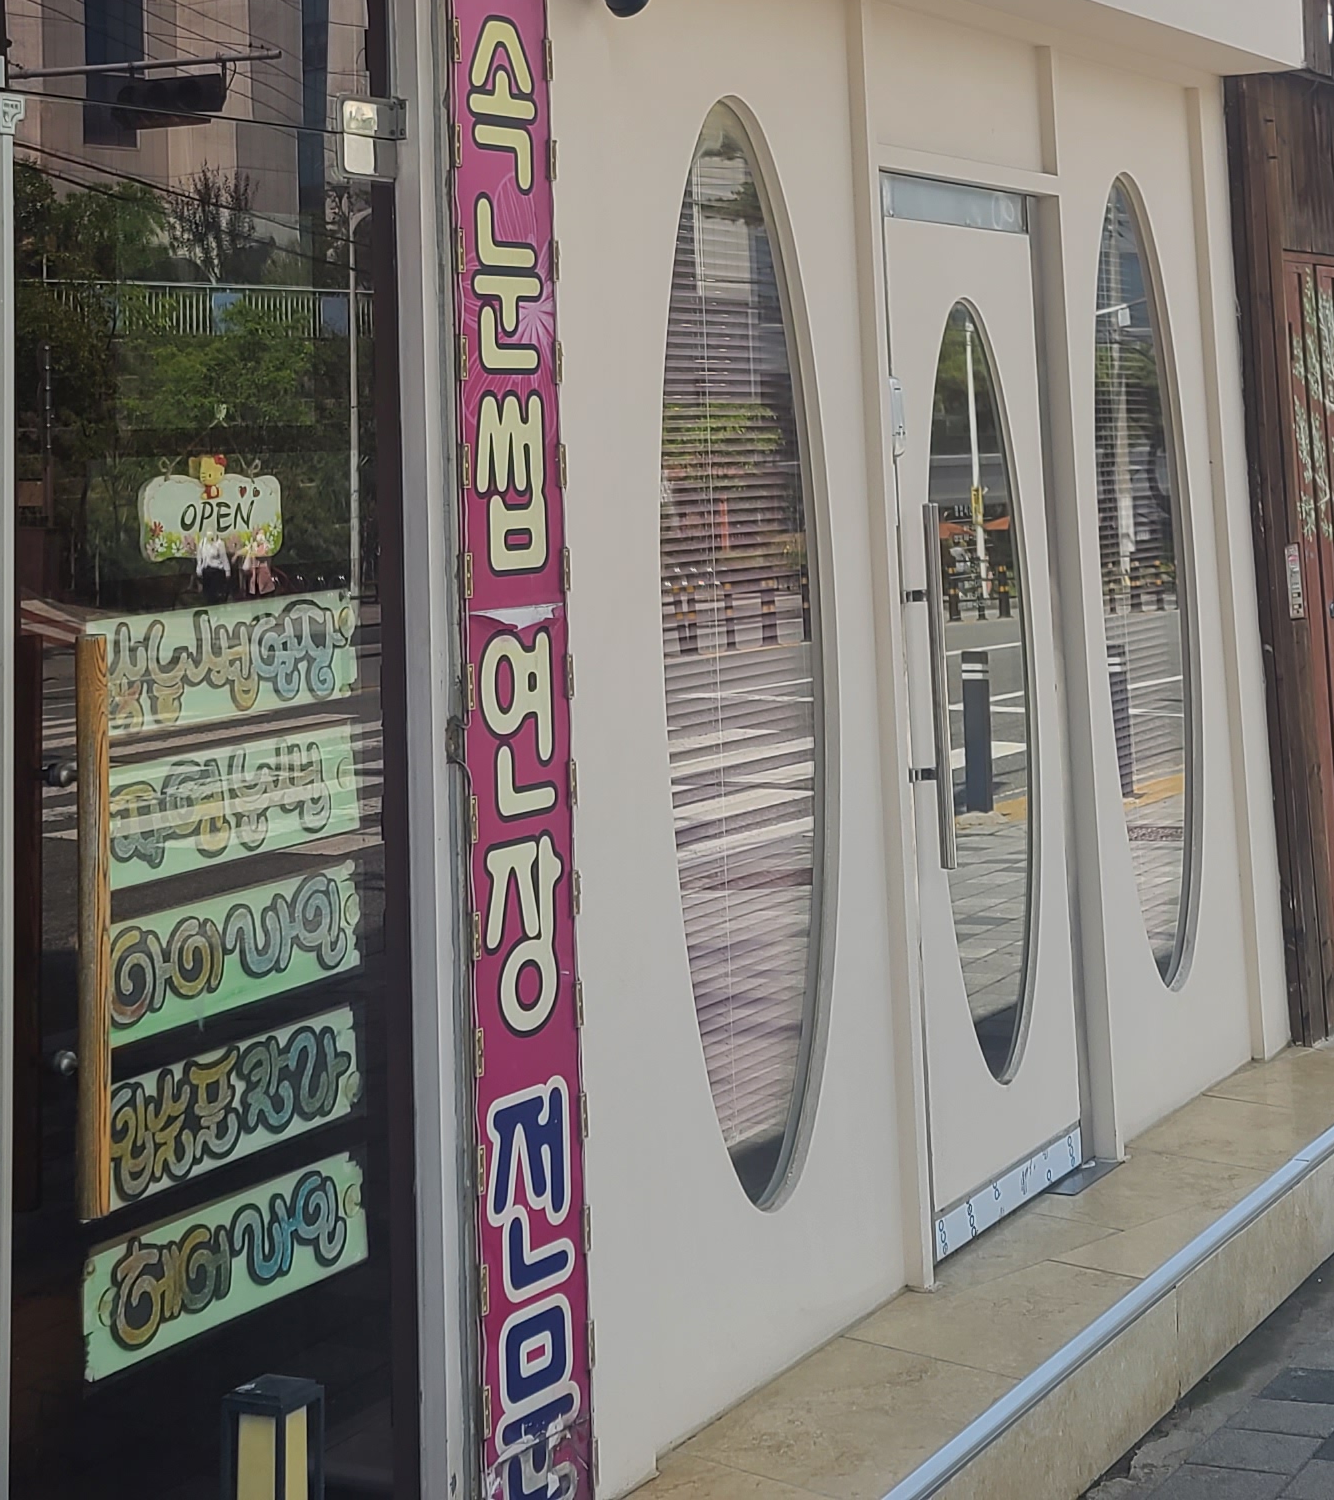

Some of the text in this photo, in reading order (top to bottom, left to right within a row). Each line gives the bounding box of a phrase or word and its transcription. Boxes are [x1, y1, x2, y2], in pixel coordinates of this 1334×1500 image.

[467, 13, 551, 577] 속눈썹
[180, 500, 255, 534] OPEN
[478, 626, 559, 1037] 연장
